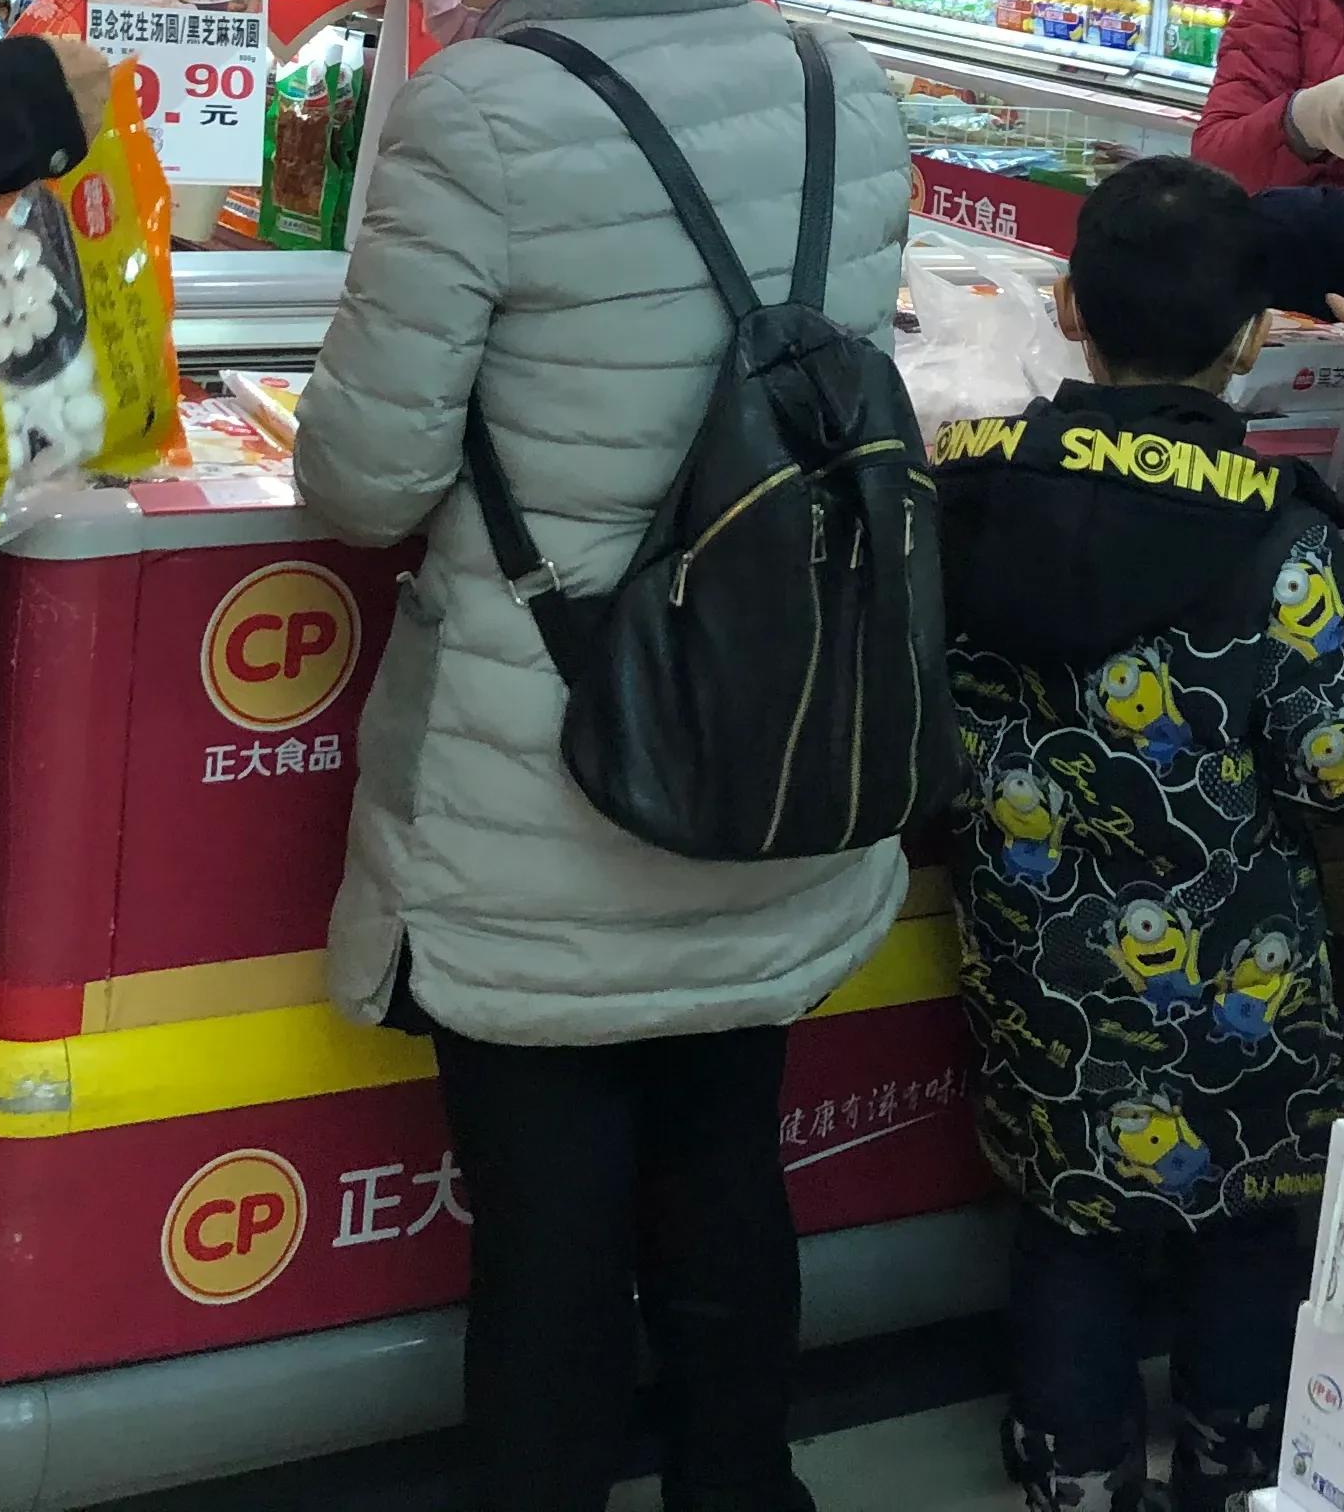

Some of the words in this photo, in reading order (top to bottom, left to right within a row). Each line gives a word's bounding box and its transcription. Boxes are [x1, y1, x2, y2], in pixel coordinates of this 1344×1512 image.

[89, 8, 261, 49] 思念花生汤圆/黑芝麻汤圆
[199, 104, 239, 126] 元
[931, 185, 1018, 239] 正大食品
[1060, 426, 1280, 513] MINIONS
[225, 610, 337, 684] CP
[201, 734, 342, 784] 正大食品
[182, 1191, 285, 1263] CP
[332, 1150, 475, 1248] 正大
